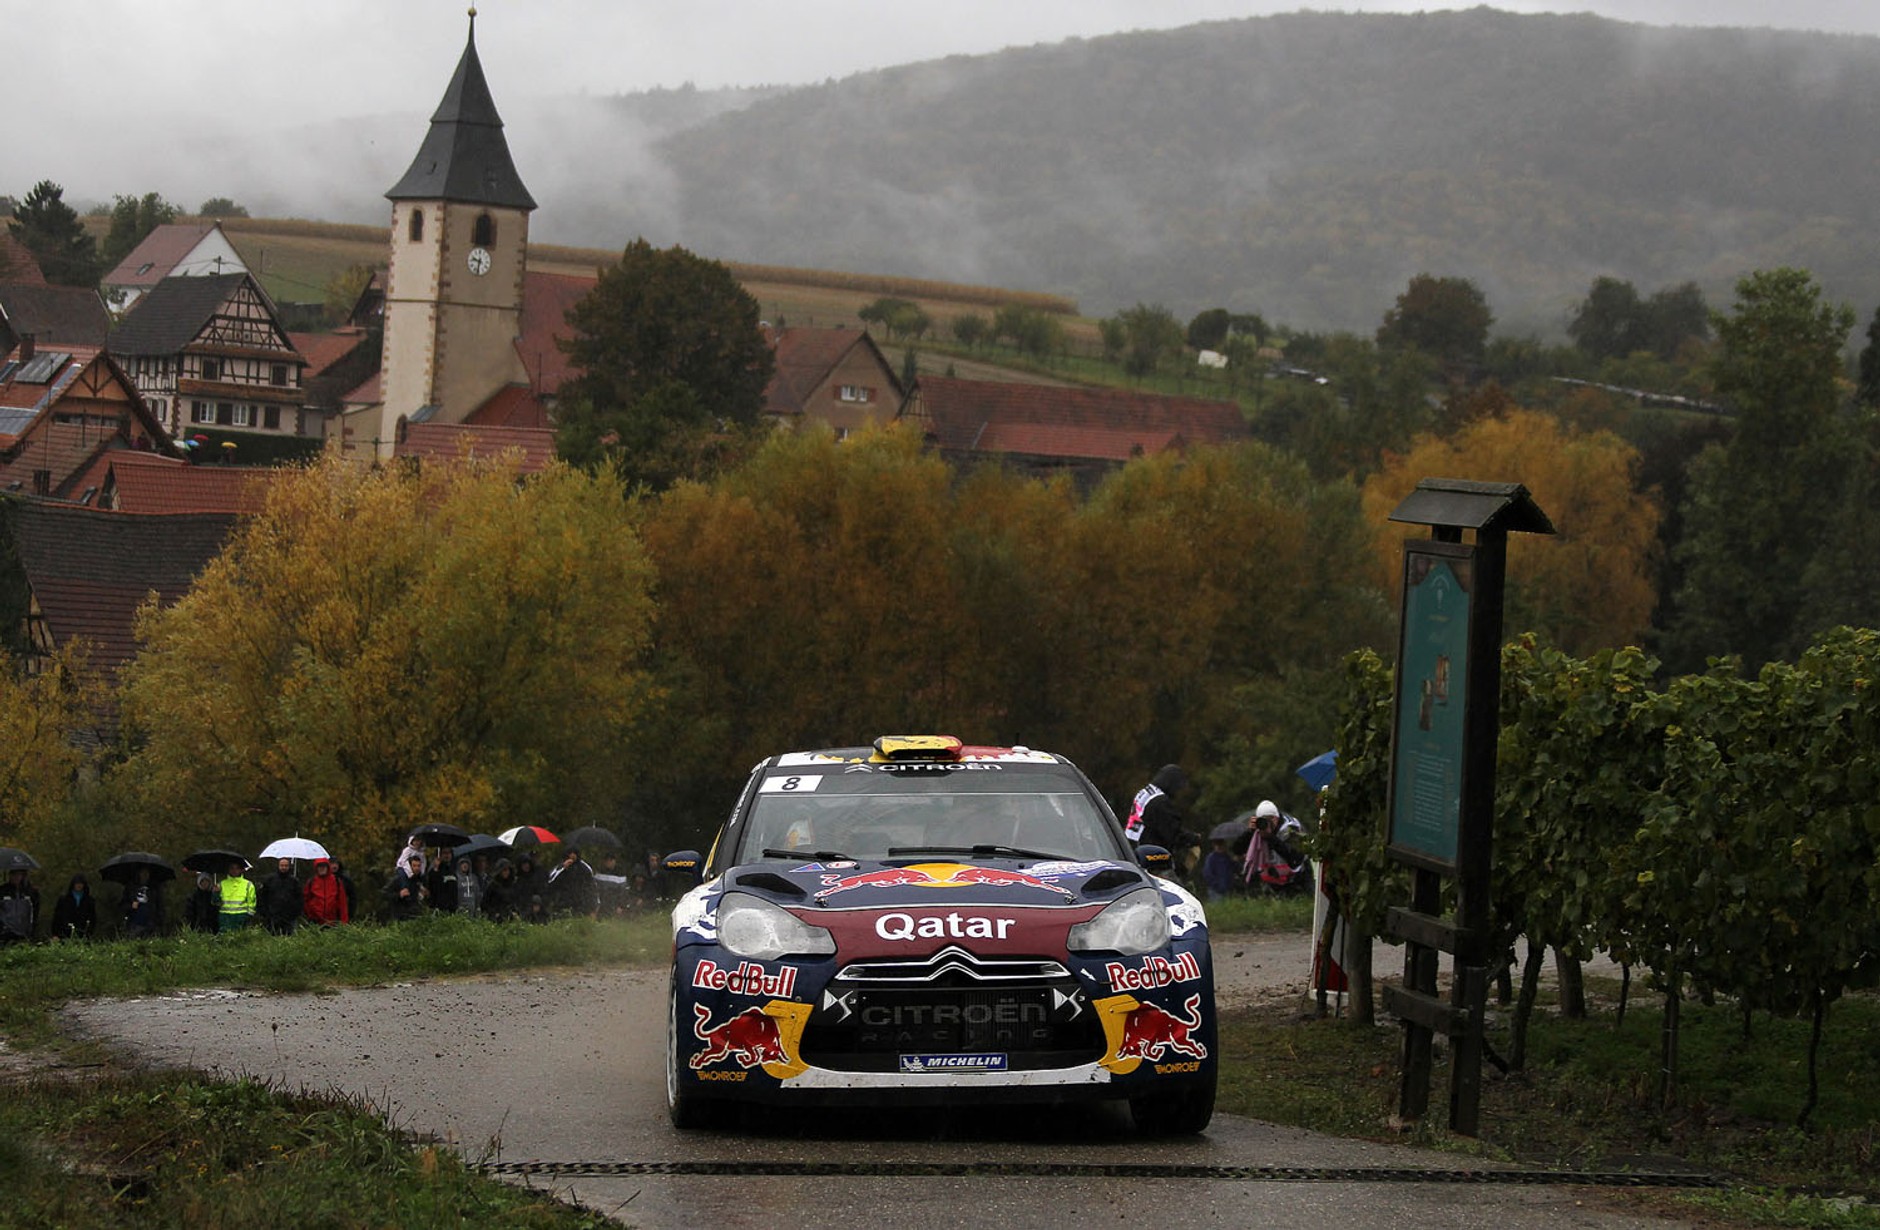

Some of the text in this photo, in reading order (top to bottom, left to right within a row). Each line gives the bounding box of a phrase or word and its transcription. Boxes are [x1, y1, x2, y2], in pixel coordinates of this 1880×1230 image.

[781, 777, 802, 791] 8
[875, 912, 1016, 941] Qatar
[922, 1056, 1002, 1067] MICHELIN
[1156, 1061, 1199, 1074] MONROE
[699, 1070, 747, 1081] MONROE
